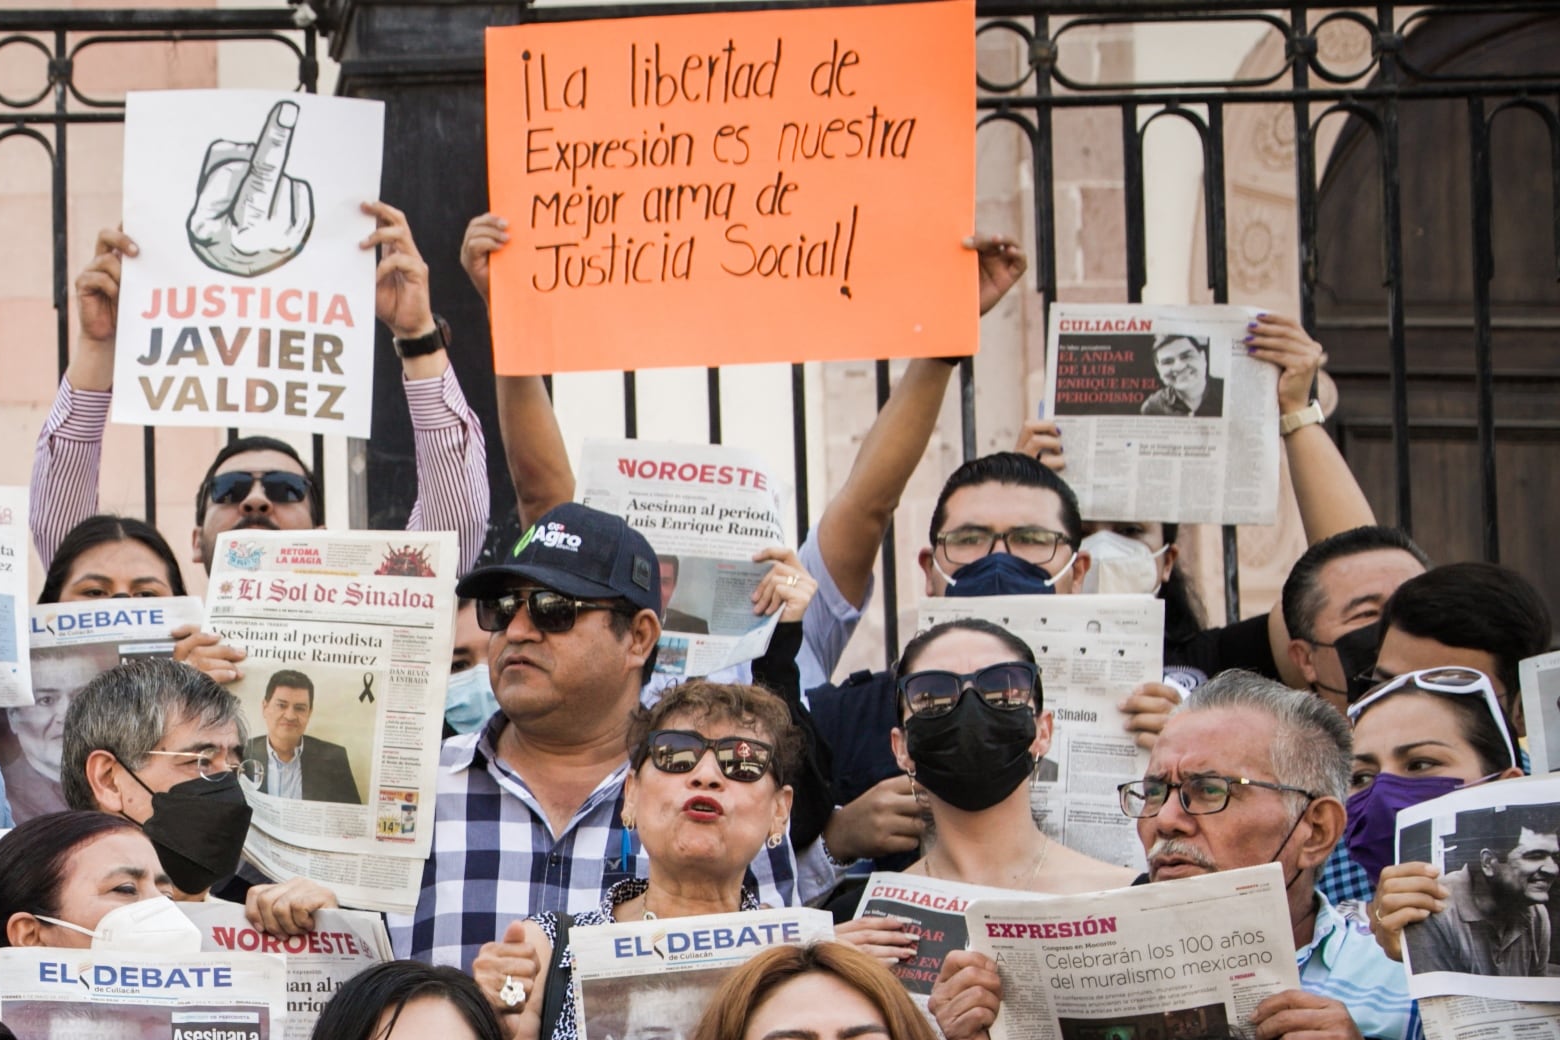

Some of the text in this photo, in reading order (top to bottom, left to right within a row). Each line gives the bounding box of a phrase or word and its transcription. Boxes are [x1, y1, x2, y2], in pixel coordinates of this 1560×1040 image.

[630, 39, 781, 107] libertad
[811, 38, 859, 97] de
[526, 106, 915, 186] Expresión es nuestra
[642, 181, 735, 223] arma
[756, 171, 798, 215] de
[533, 205, 858, 299] Justicia Social!
[141, 285, 354, 327] JUSTICIA
[1060, 317, 1152, 332] CULIACÁN
[137, 326, 344, 375] JAVIER
[1059, 351, 1134, 362] EL ANDAR
[1058, 365, 1115, 375] DE LUIS
[1058, 378, 1118, 390] ENRIQUE
[1120, 378, 1139, 389] EN
[138, 376, 345, 420] VALDEZ
[1057, 392, 1144, 403] PERIODISMO
[618, 458, 768, 491] NOROESTE
[627, 499, 696, 515] Asesinan
[701, 504, 715, 516] al
[531, 525, 582, 547] Agro
[626, 515, 657, 528] Luis
[662, 517, 723, 534] Enrique
[280, 548, 319, 556] RETOMA
[291, 557, 322, 565] MAGIA
[238, 578, 434, 609] El Sol de Sinaloa
[30, 610, 164, 633] L DEBATE
[284, 632, 297, 642] al
[302, 632, 383, 648] periodista
[245, 646, 377, 666] Enrique Ramírez
[1058, 709, 1097, 722] Sinaloa
[986, 916, 1117, 939] EXPRESIÓN
[212, 927, 360, 955] NOROESTE
[614, 922, 801, 959] EL DEBATE
[1045, 928, 1265, 970] Celebrarán los 100 años
[679, 951, 713, 960] Culiacán
[39, 962, 232, 988] EL DEBATE
[1050, 950, 1273, 989] del muralismo mexicano
[317, 977, 331, 992] al
